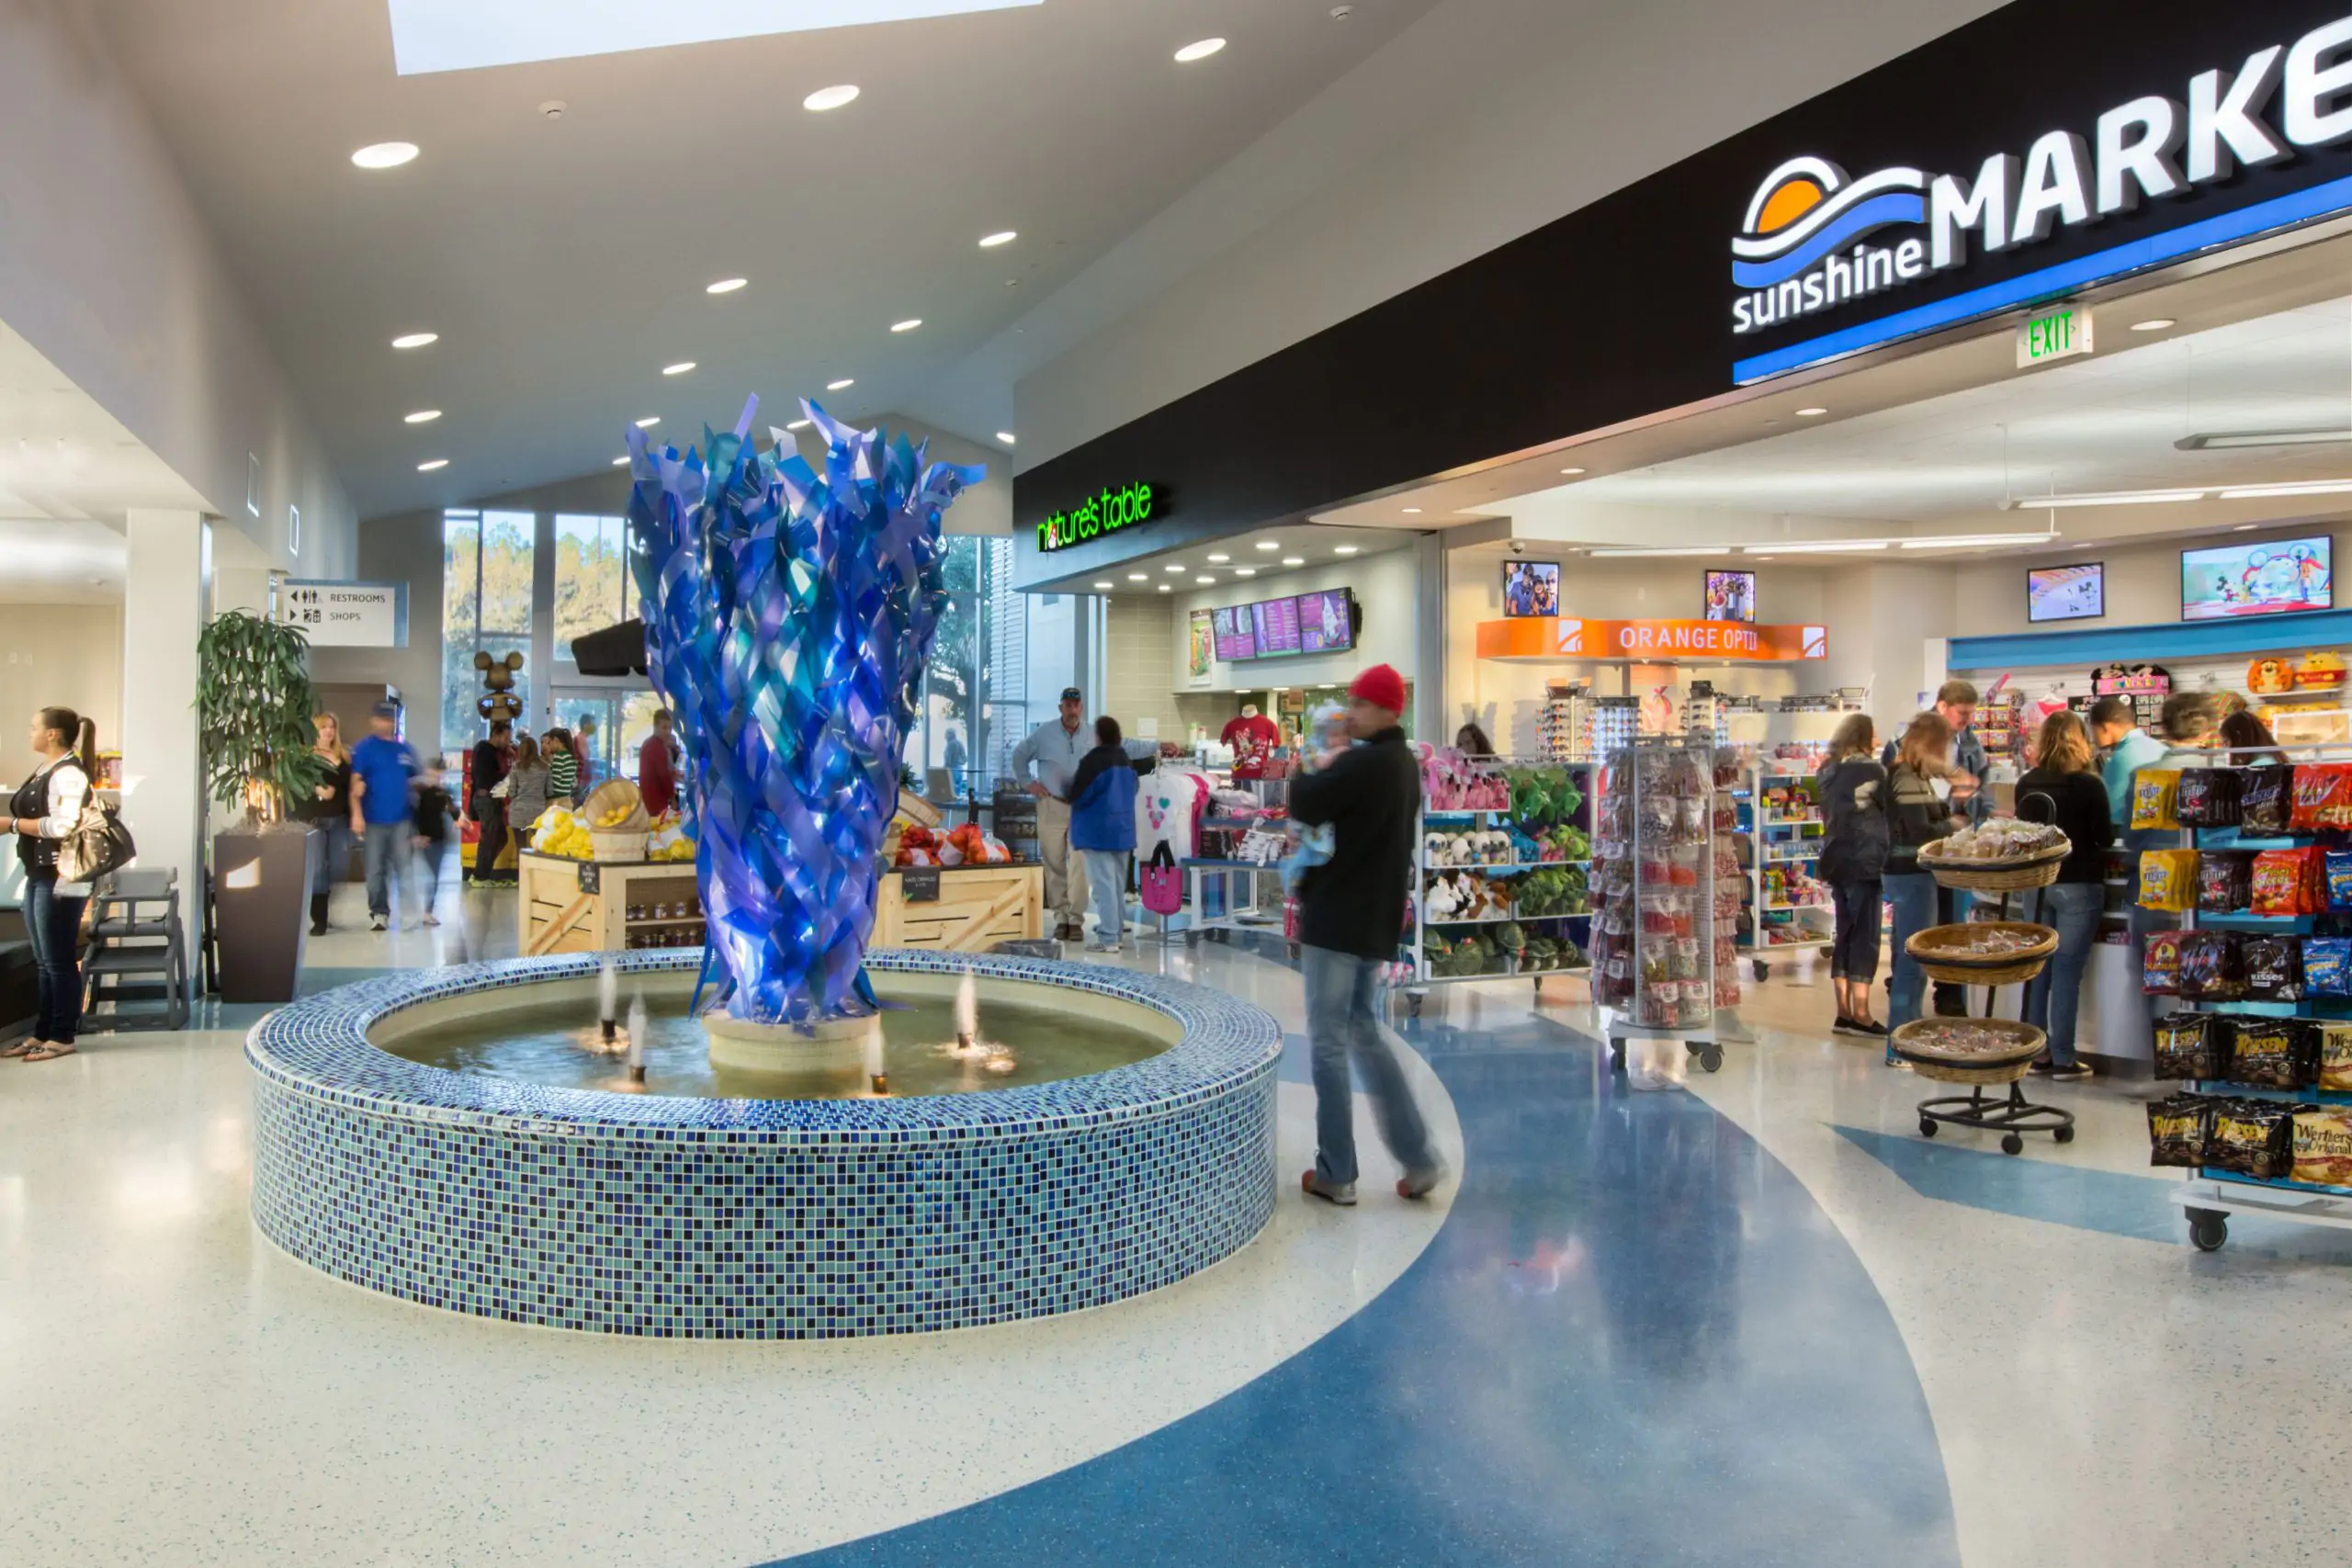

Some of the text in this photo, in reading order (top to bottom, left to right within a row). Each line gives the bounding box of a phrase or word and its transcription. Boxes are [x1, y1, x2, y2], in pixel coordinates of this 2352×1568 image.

[1931, 15, 2352, 269] MARKE
[1733, 237, 1926, 333] sunshine
[2029, 310, 2074, 358] EXIT
[1101, 480, 1151, 530] table
[329, 612, 361, 622] SHOPS
[330, 593, 386, 604] RESTROOMS
[1620, 626, 1718, 649] ORANGE
